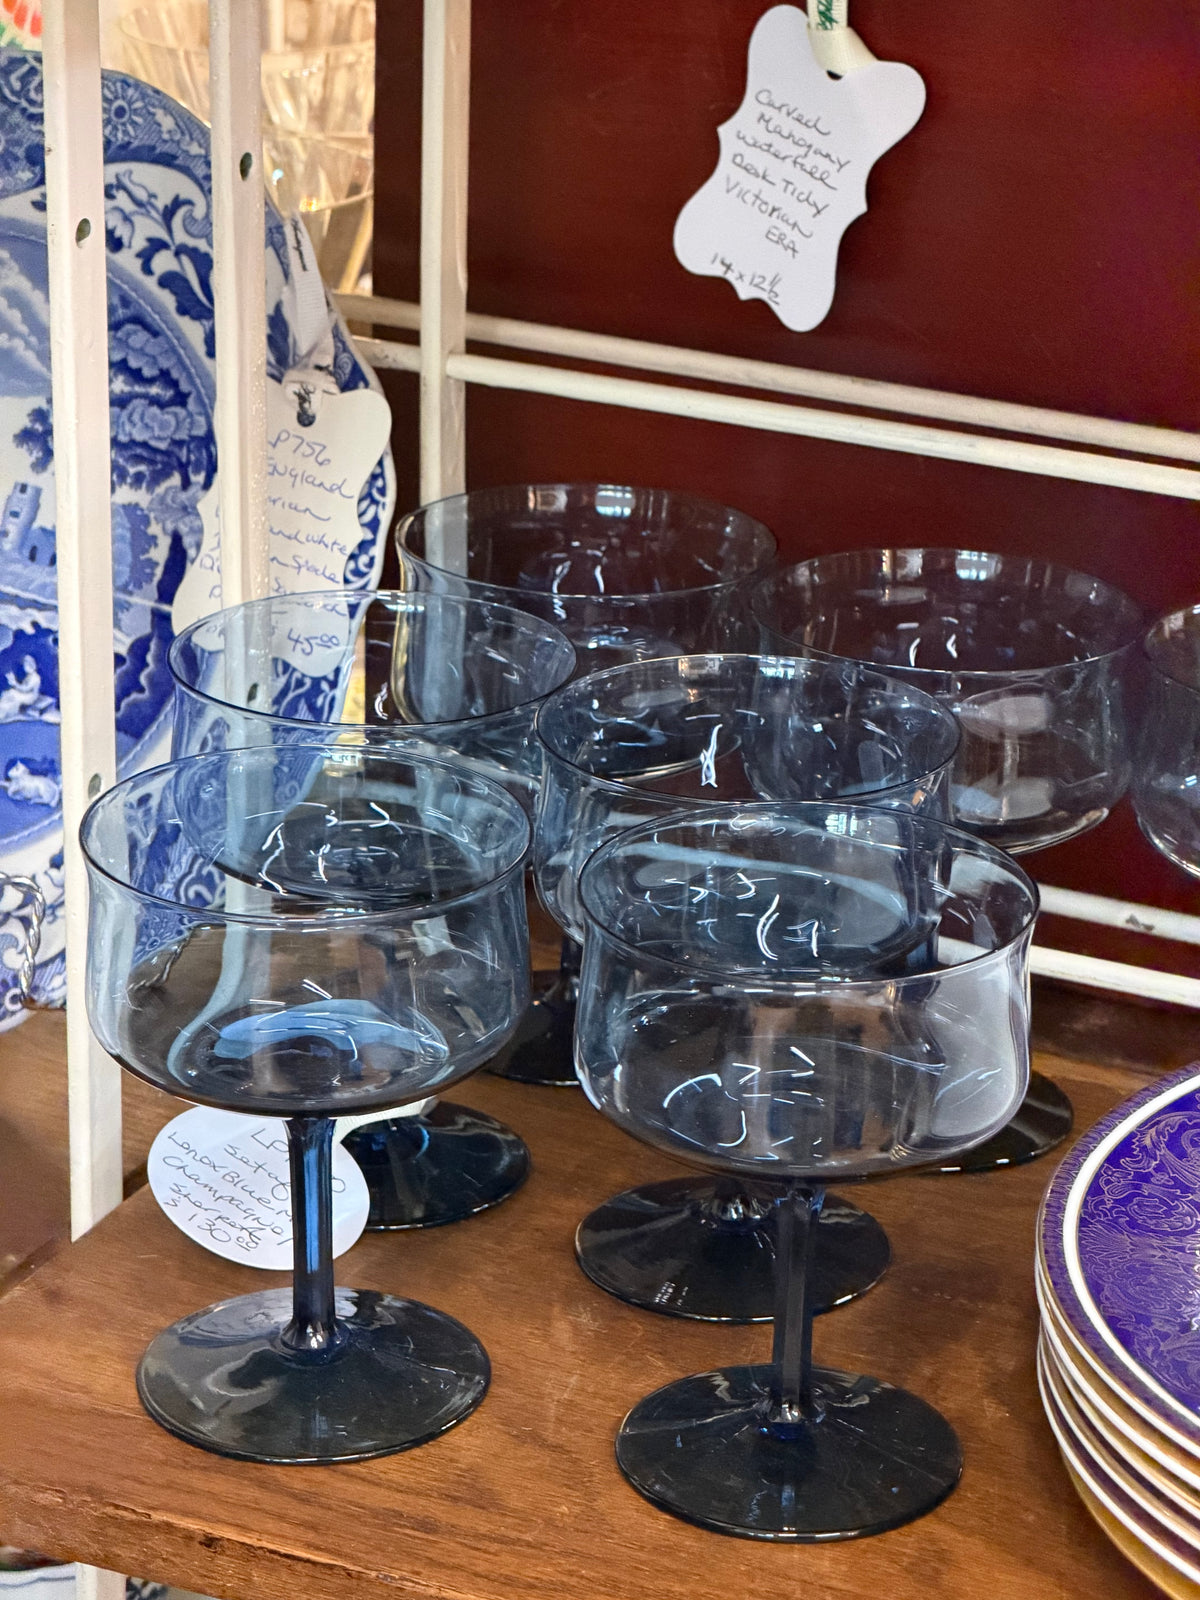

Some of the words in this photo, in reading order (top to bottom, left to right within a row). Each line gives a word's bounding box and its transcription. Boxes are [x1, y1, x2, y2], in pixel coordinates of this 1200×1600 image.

[755, 89, 831, 135] Carved
[765, 225, 799, 259] ERA
[221, 1171, 276, 1211] Blue
